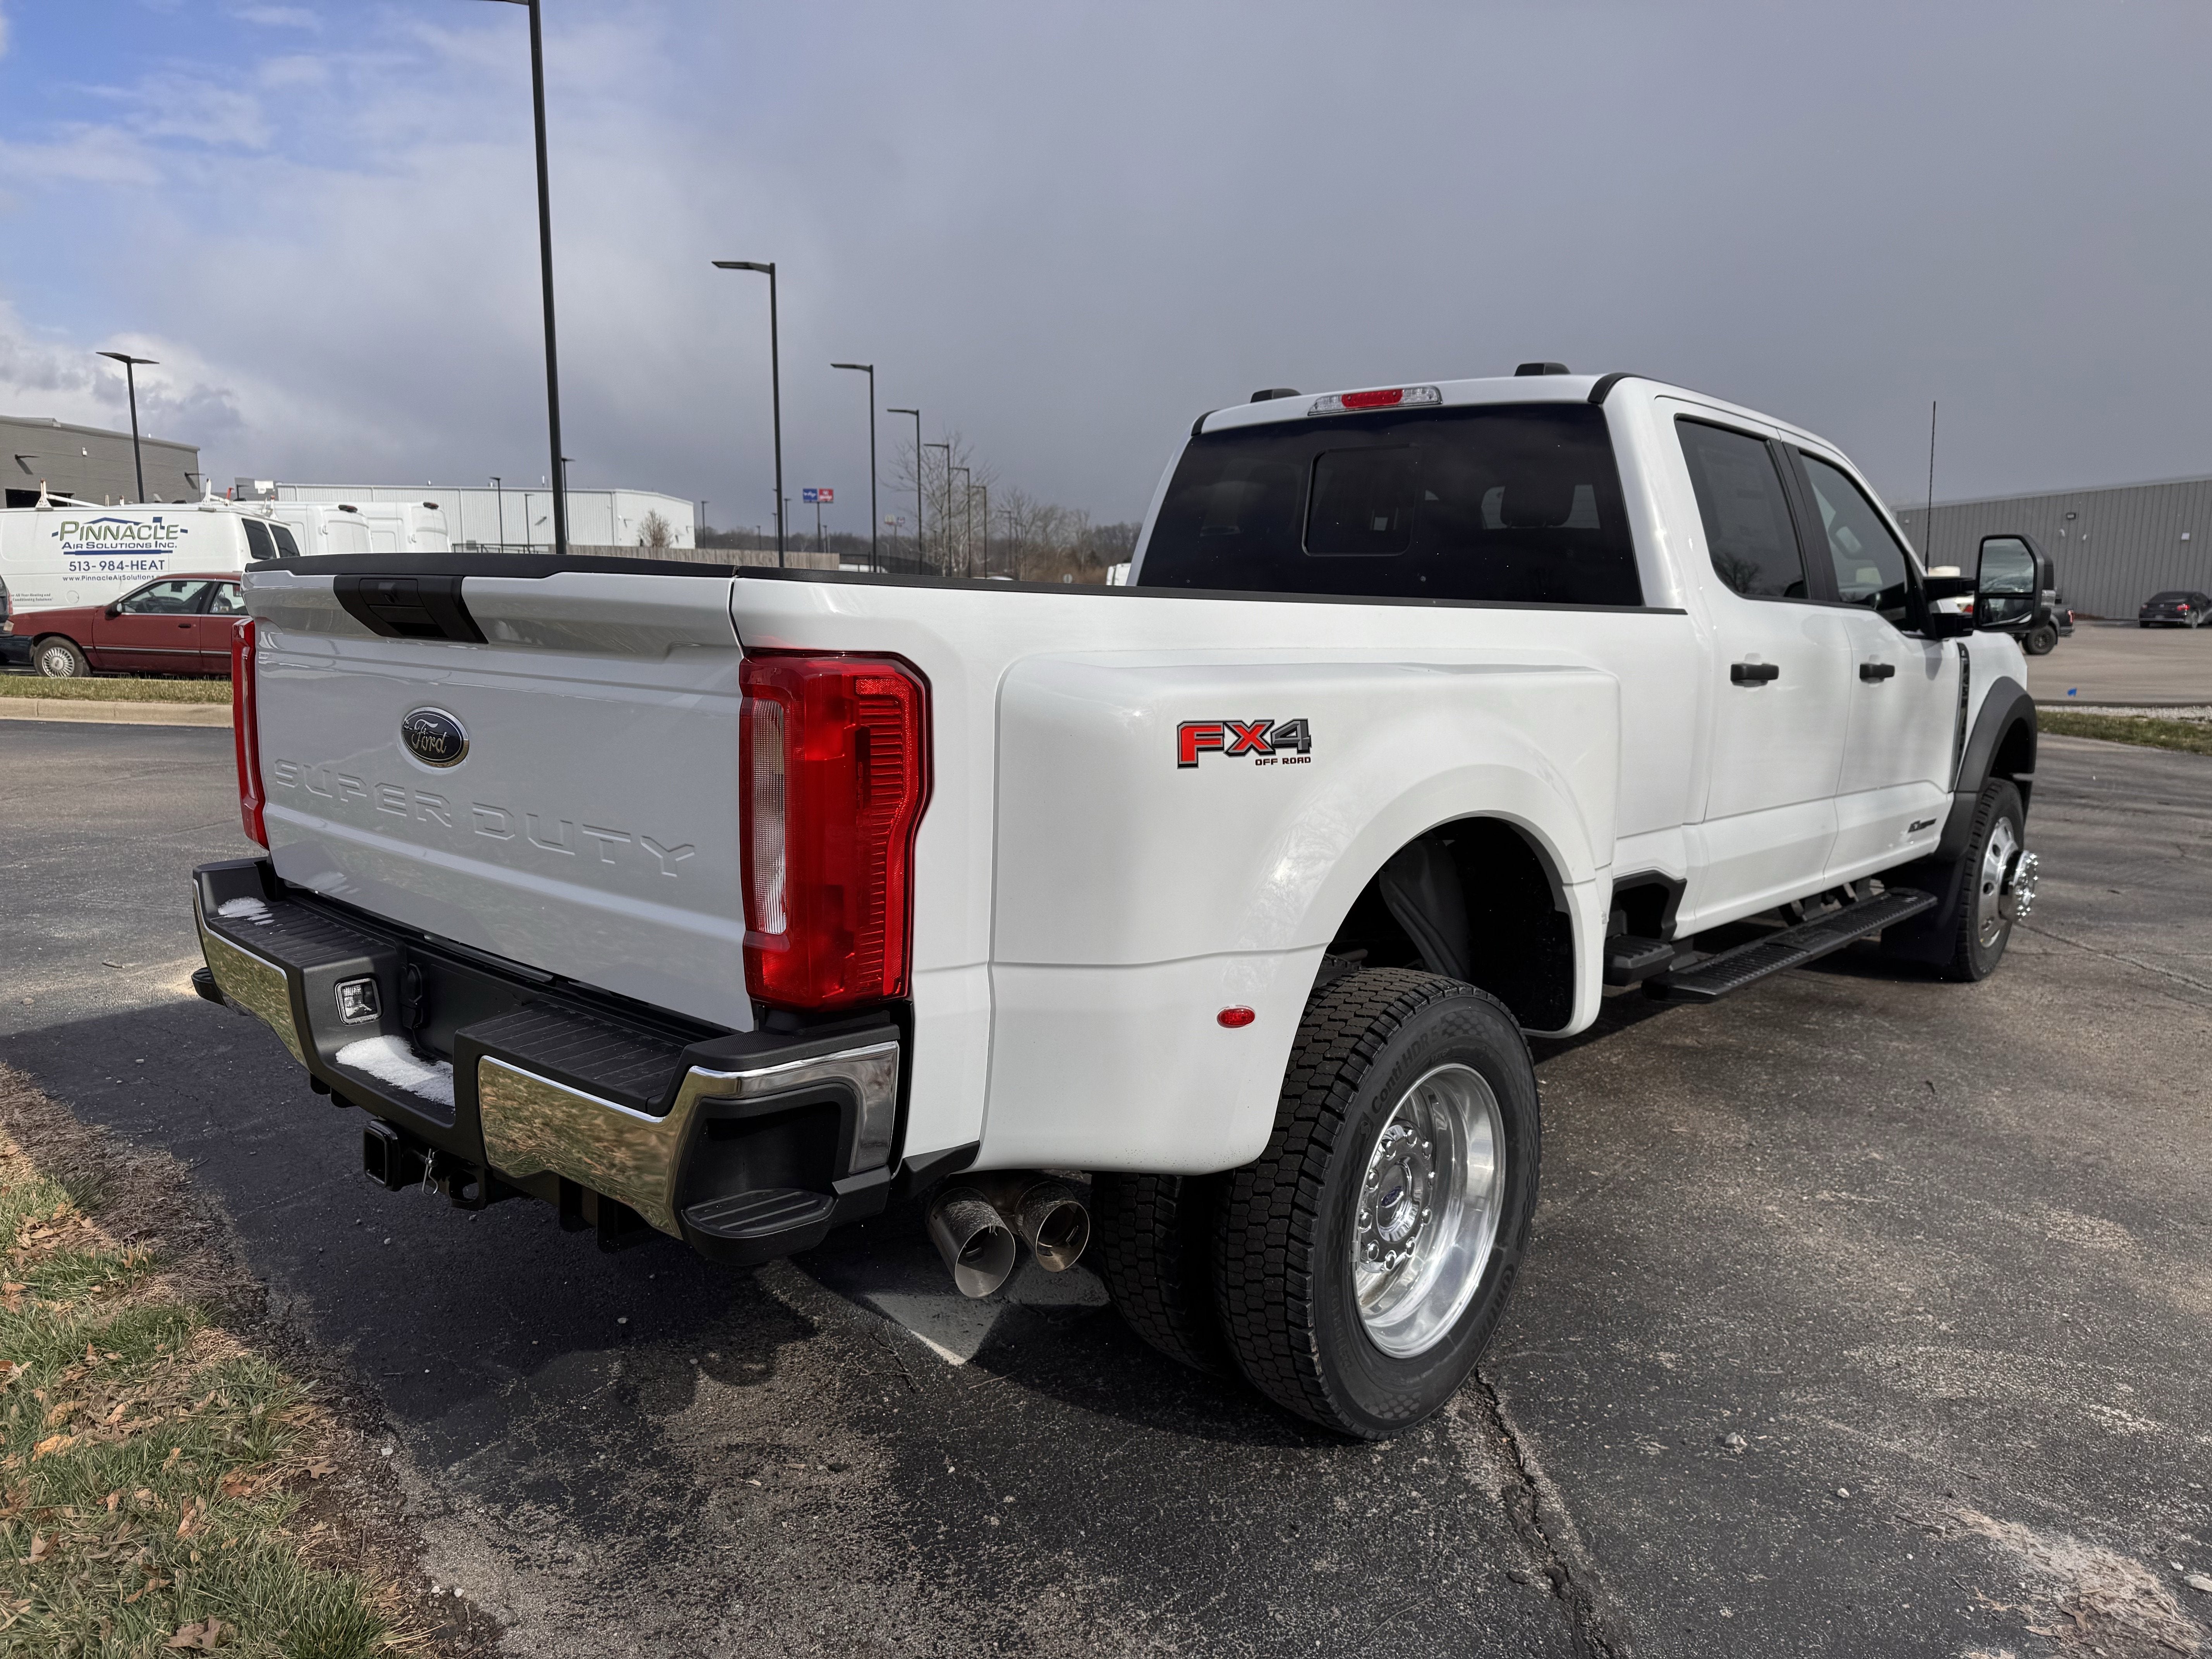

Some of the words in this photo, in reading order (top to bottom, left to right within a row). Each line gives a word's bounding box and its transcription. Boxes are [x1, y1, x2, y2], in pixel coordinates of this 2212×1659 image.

[60, 521, 179, 541] PINNACLE
[411, 719, 447, 753] Ford
[1176, 718, 1312, 769] FX4
[1255, 758, 1278, 766] OFF
[1282, 757, 1311, 765] ROAD
[273, 758, 452, 828] SUPER
[472, 802, 695, 878] DUTY
